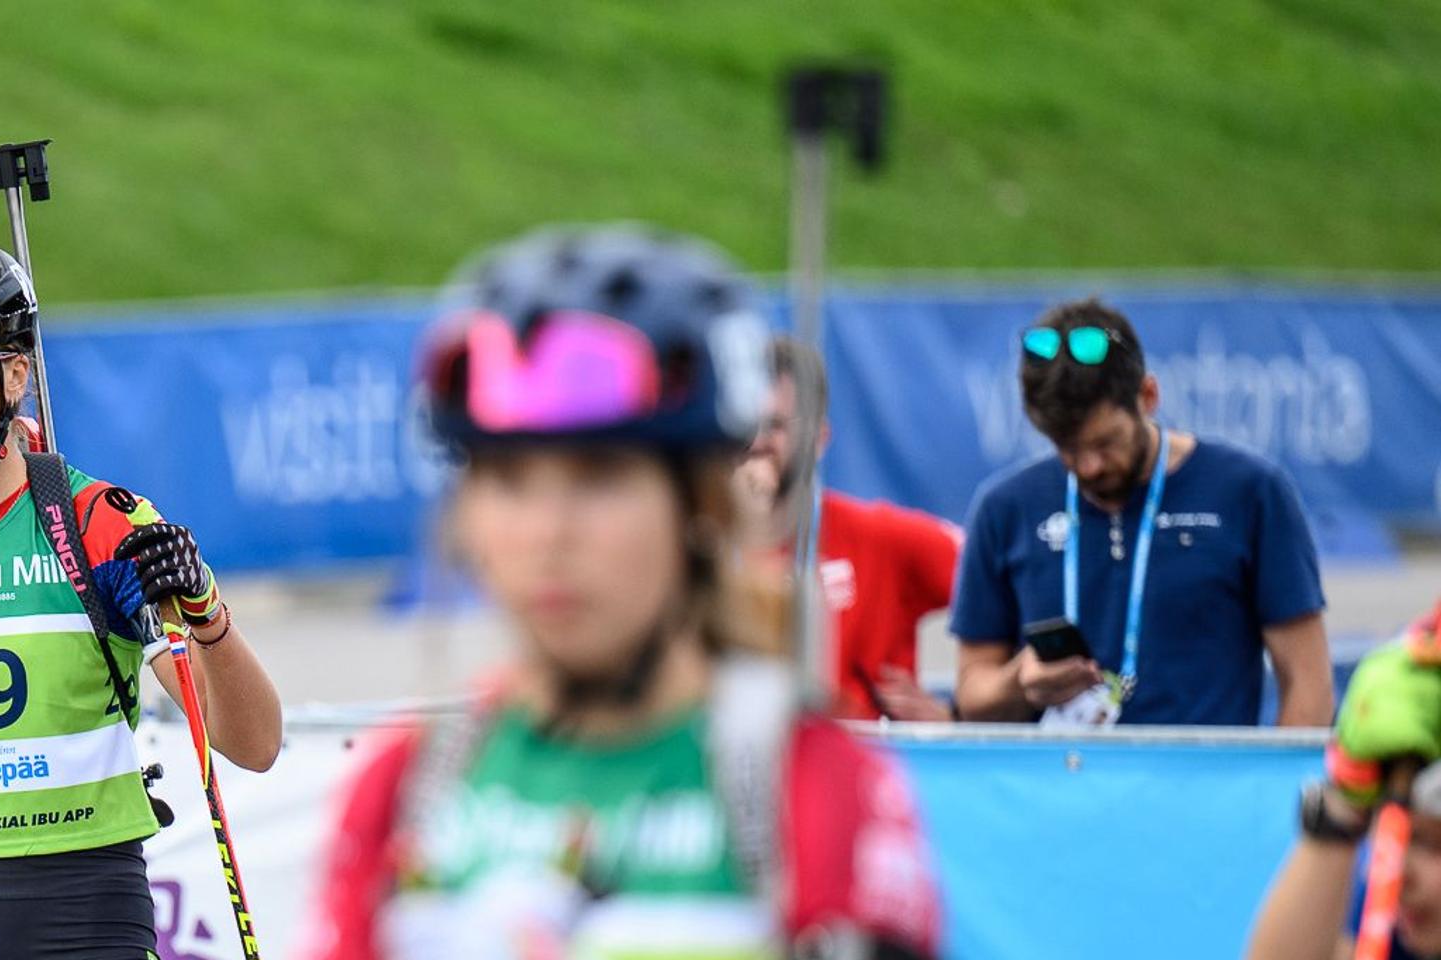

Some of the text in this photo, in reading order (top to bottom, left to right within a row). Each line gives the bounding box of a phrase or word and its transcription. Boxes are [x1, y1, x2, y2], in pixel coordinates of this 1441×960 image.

[1148, 323, 1372, 465] stonia
[45, 504, 88, 593] PINGU
[31, 811, 60, 827] IBU
[63, 807, 95, 823] APP
